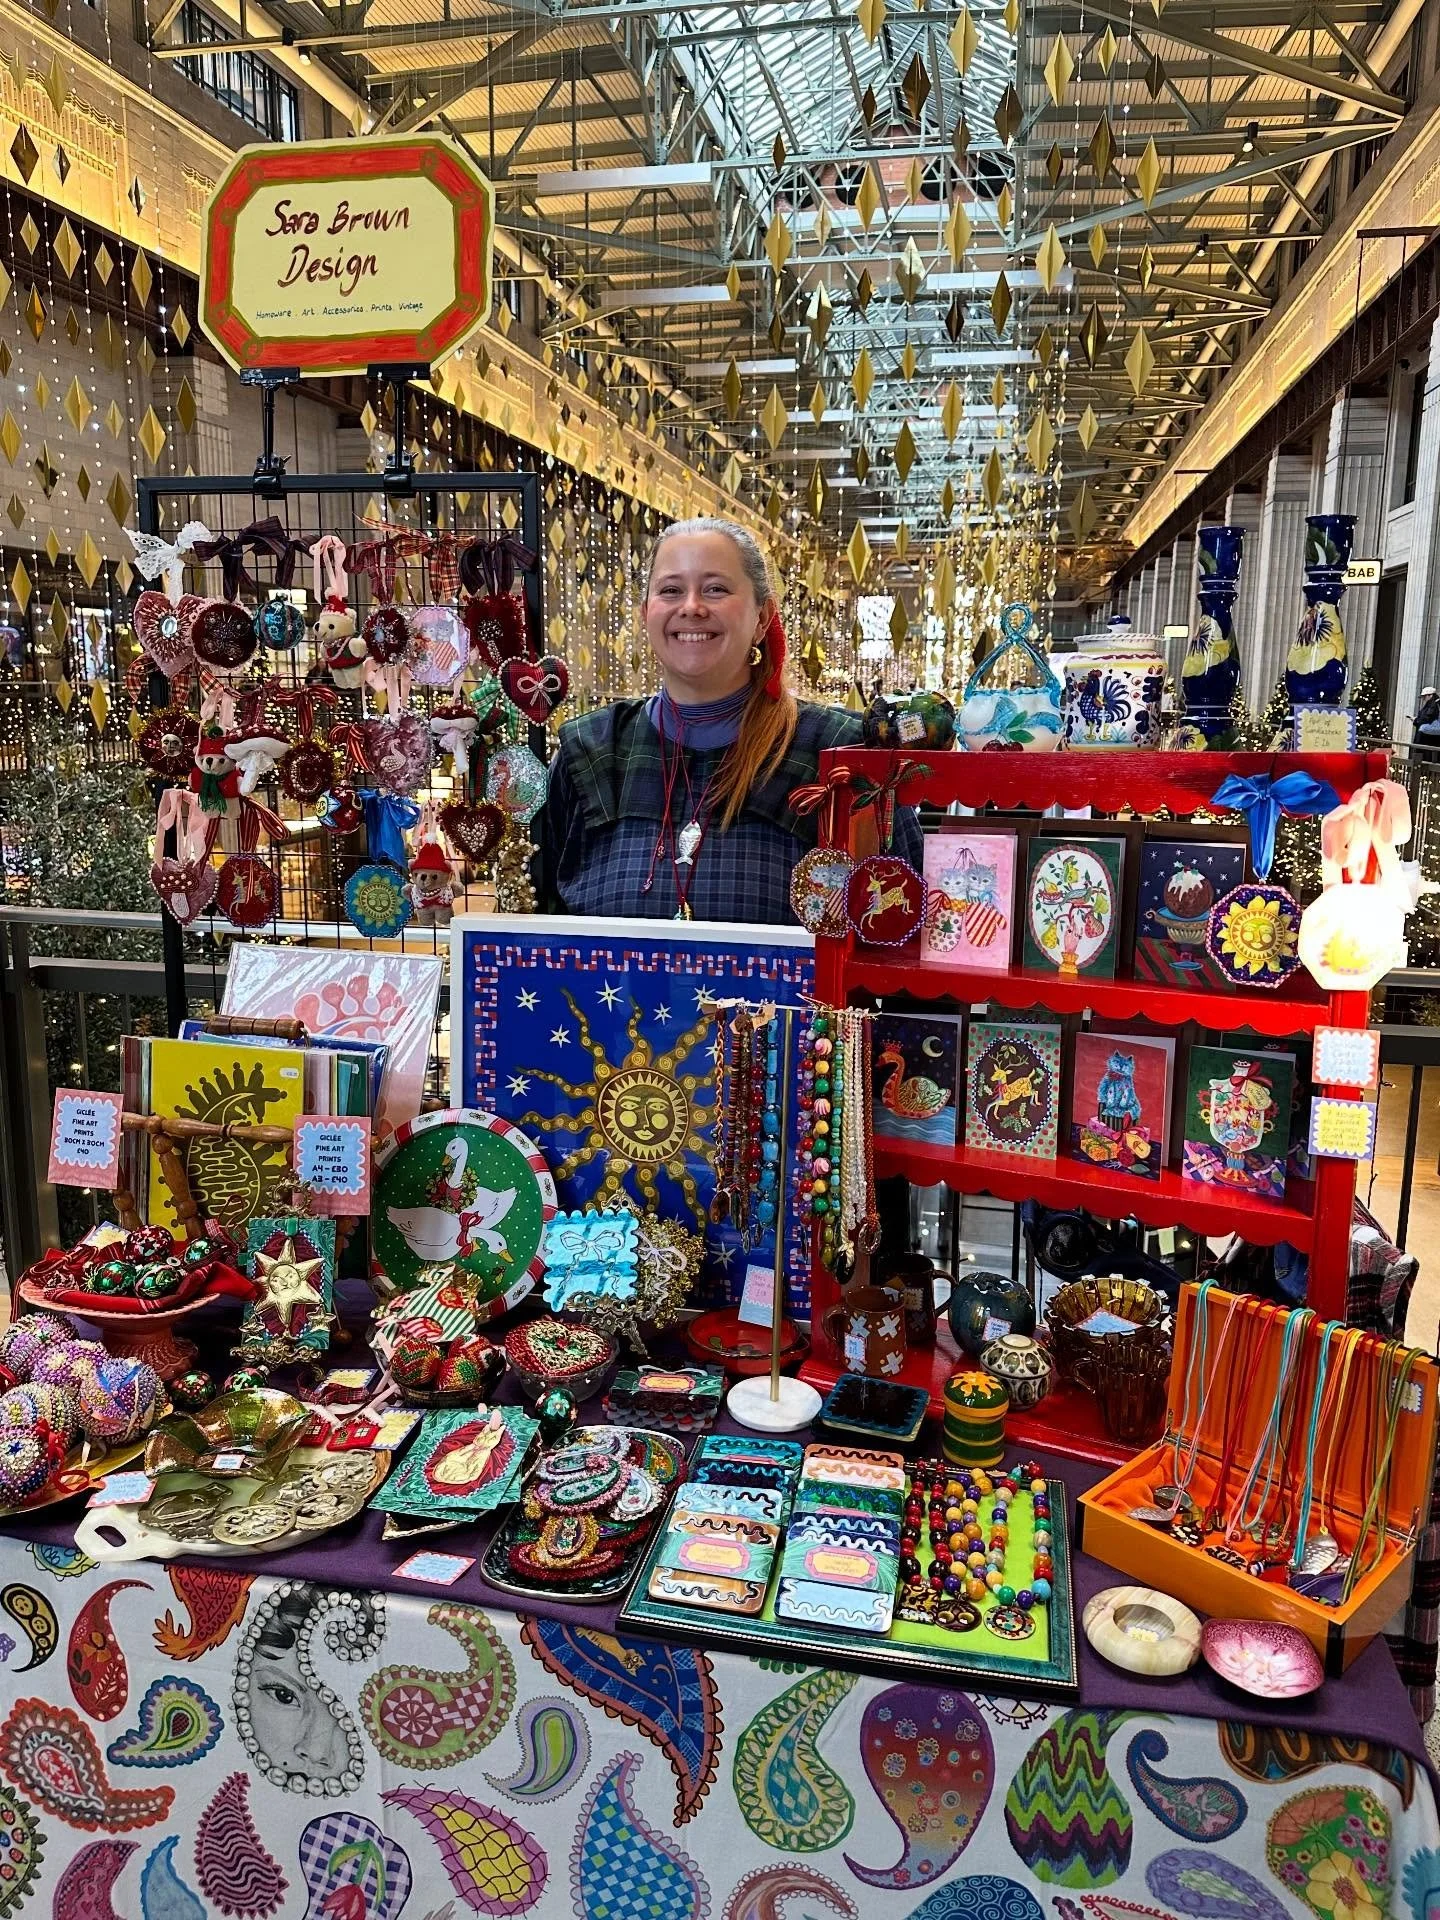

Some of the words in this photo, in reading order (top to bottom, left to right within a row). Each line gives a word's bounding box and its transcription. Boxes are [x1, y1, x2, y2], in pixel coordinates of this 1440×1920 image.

[265, 199, 320, 237] Sara
[326, 200, 410, 236] Brown
[277, 243, 379, 297] Design
[256, 309, 292, 320] Homeware
[301, 308, 316, 317] Art
[371, 303, 393, 312] Prints
[399, 301, 424, 313] Vintage
[1347, 567, 1375, 578] BAB
[72, 1118, 84, 1126] FINE
